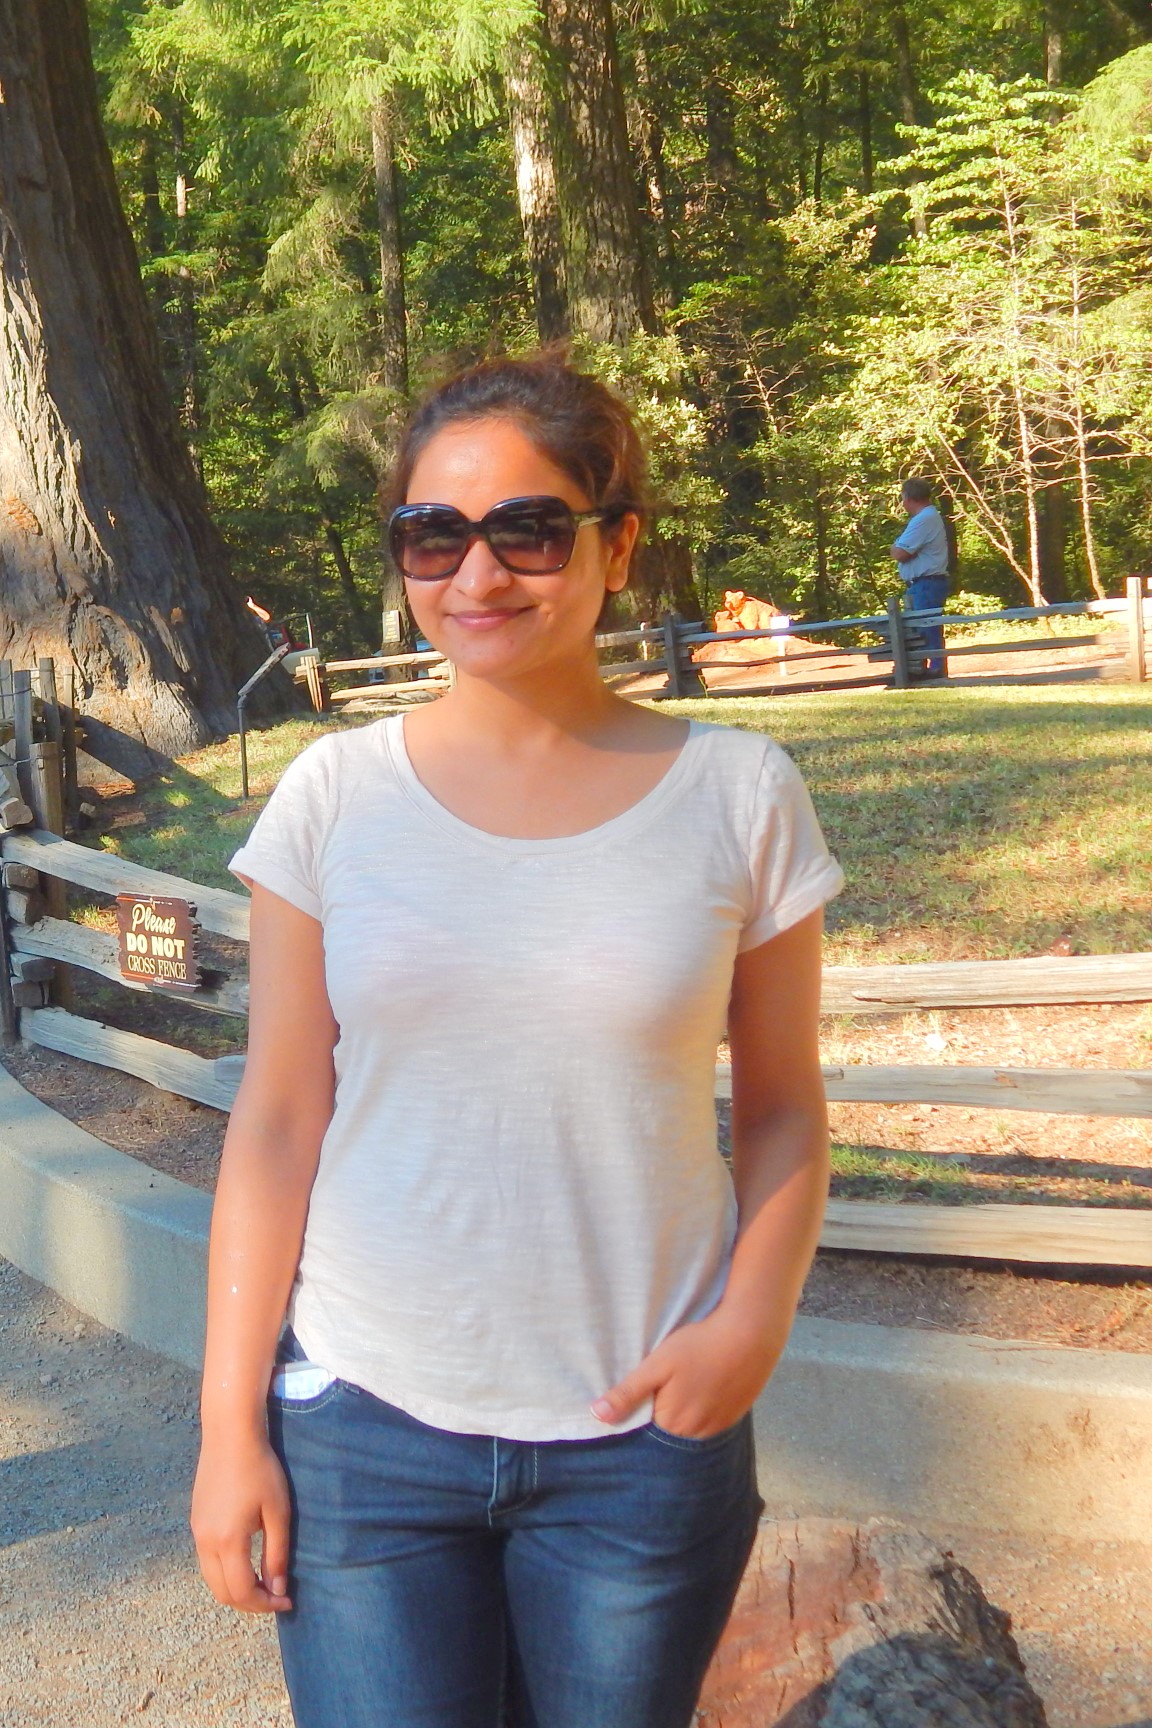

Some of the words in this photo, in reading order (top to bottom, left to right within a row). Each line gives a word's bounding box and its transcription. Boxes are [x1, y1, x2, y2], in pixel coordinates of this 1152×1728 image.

[132, 903, 176, 934] Please
[126, 932, 148, 954] DO
[151, 935, 185, 959] NOT
[128, 954, 156, 975] CROSS
[157, 959, 187, 980] FENCE
